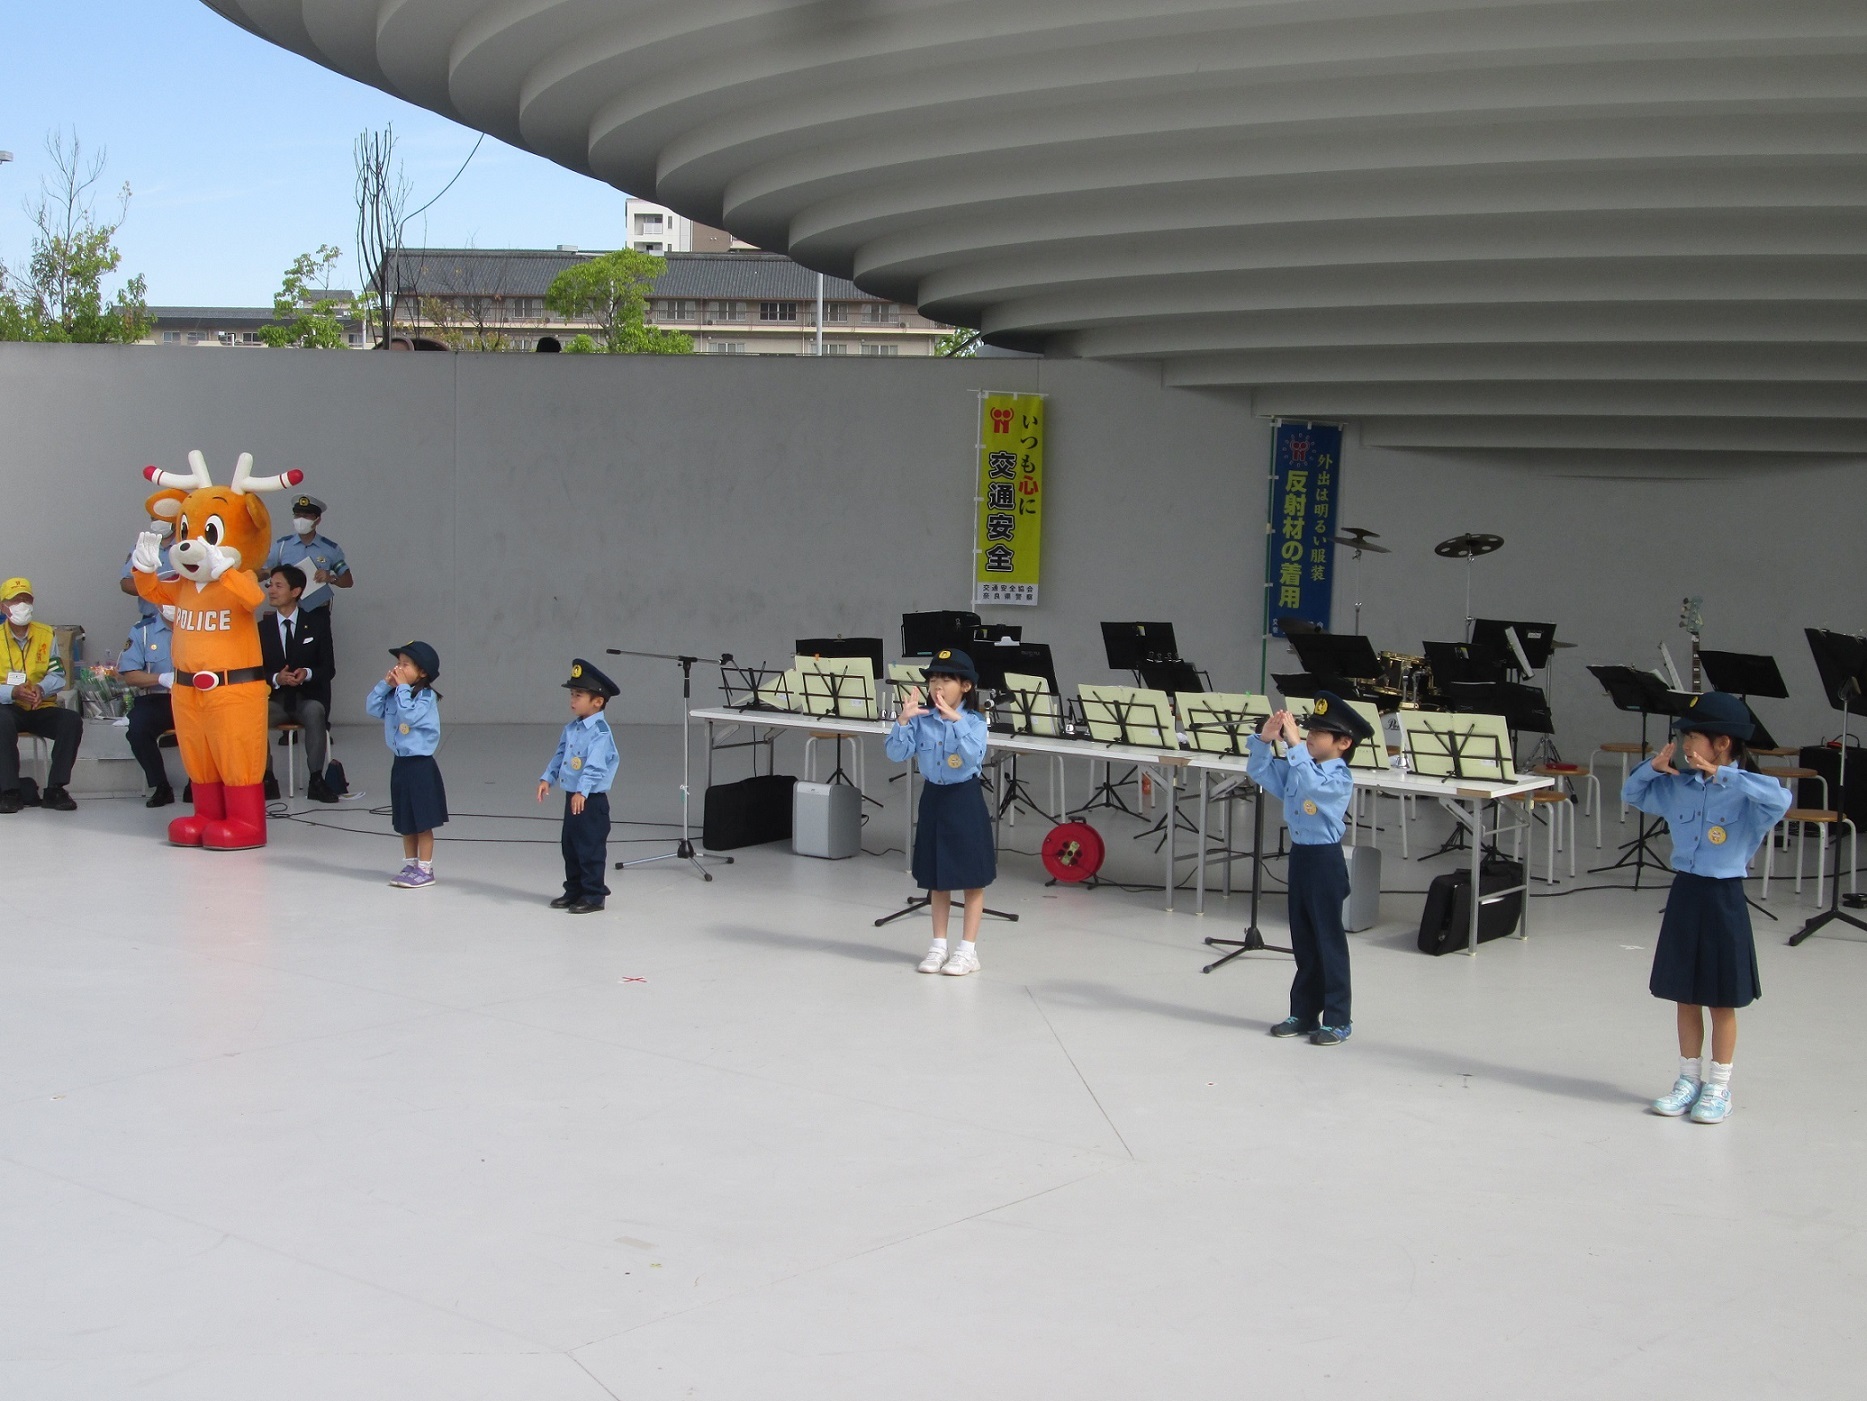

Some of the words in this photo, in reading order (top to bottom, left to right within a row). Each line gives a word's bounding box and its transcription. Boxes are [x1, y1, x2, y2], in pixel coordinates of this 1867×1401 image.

[985, 451, 1017, 573] 交通安全
[1018, 414, 1039, 515] いつも心に
[1311, 454, 1333, 581] 外出は明るい服装
[1278, 470, 1309, 608] 反射材の着用
[176, 607, 231, 631] POLICE
